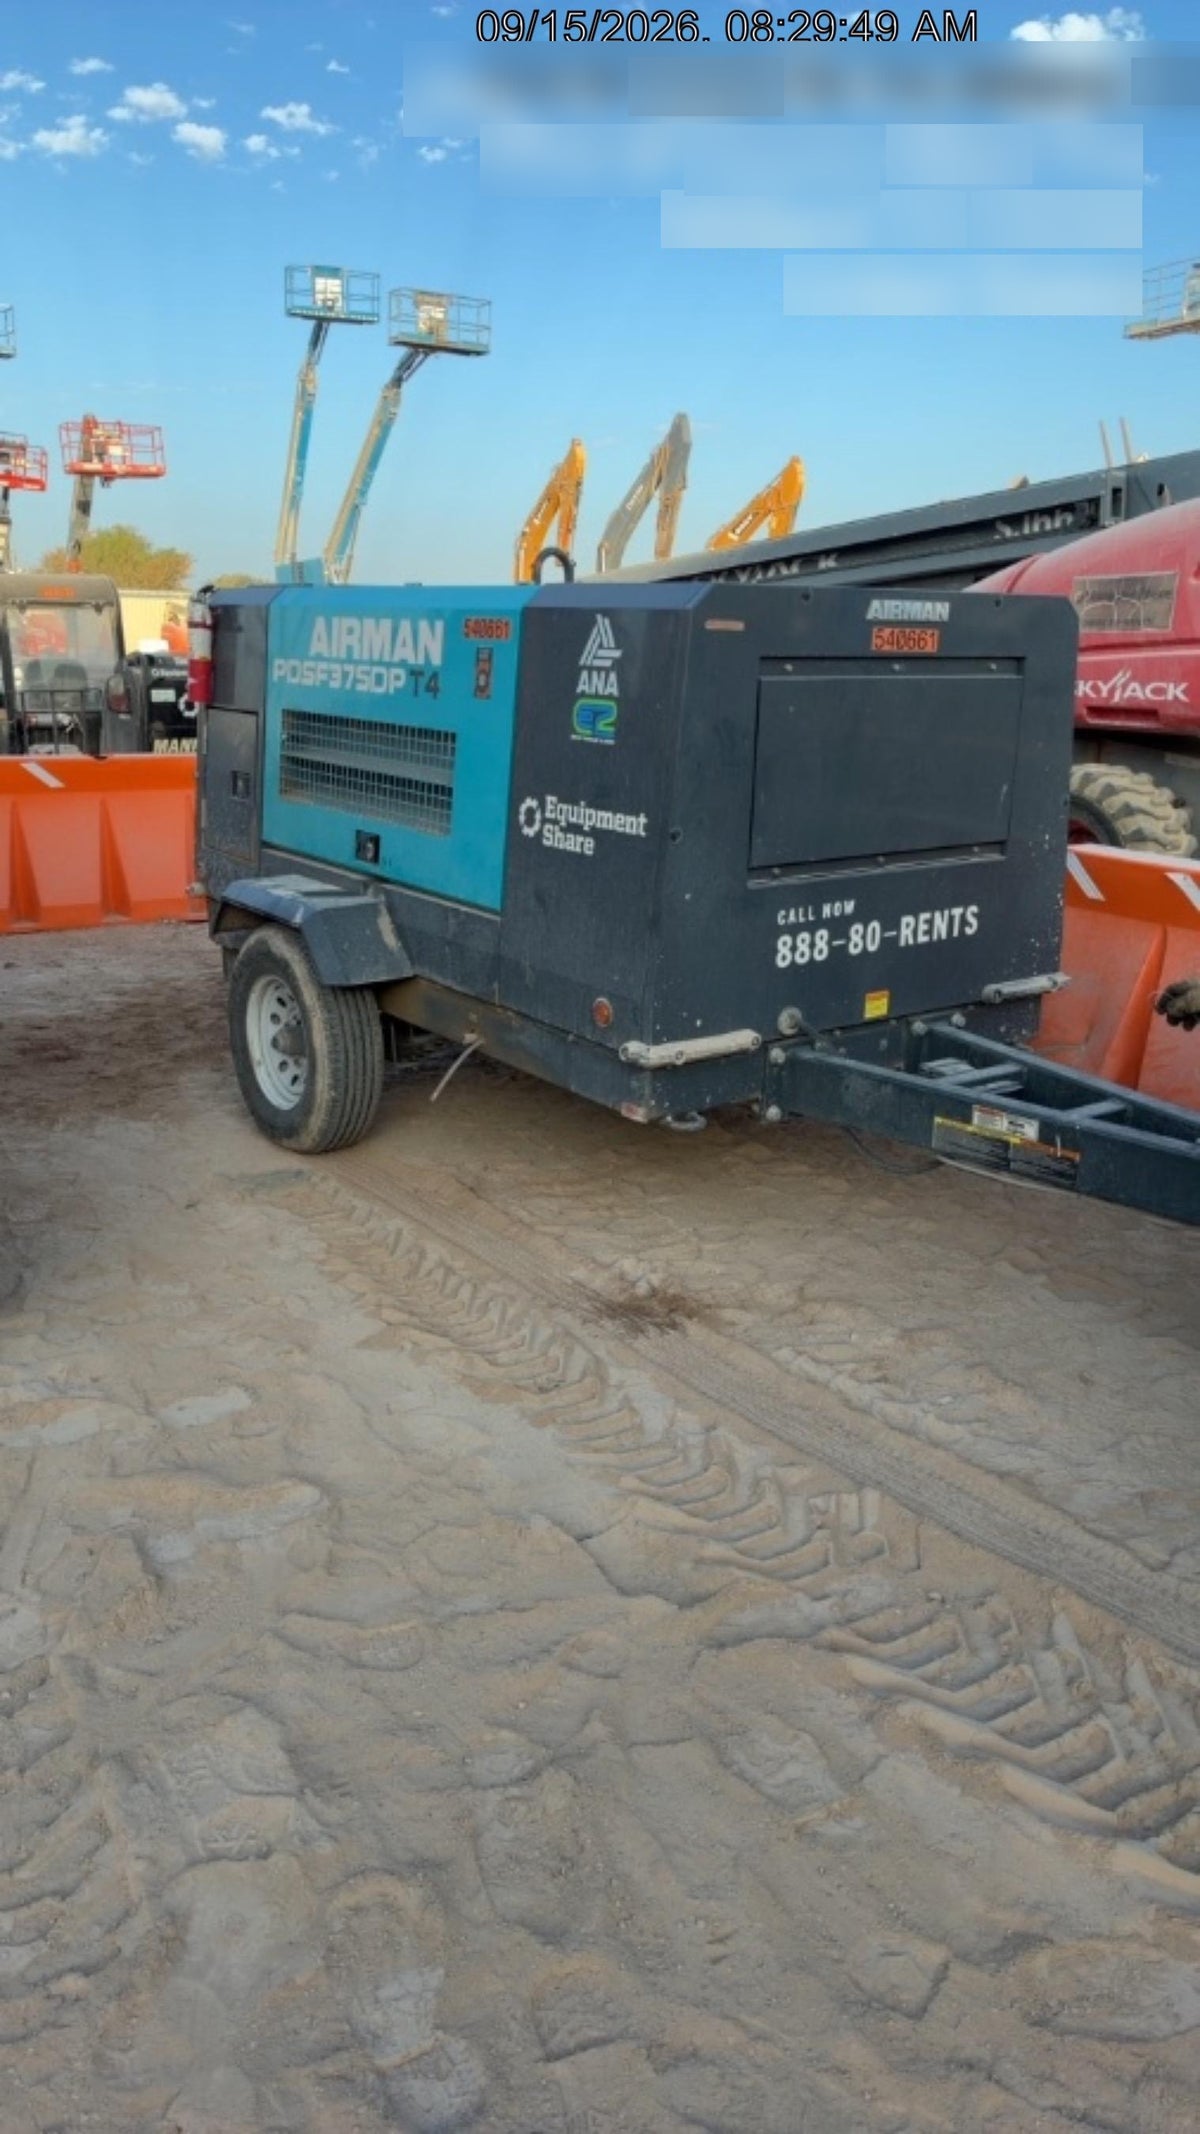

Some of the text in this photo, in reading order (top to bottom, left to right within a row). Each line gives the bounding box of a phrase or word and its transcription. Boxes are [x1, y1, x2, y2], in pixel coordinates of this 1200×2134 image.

[865, 599, 950, 622] AIRMAN
[307, 615, 445, 667] AIRMAN
[872, 628, 939, 652] 540661
[409, 670, 441, 700] T4
[576, 669, 619, 698] ANA
[1074, 667, 1190, 704] KYJACK
[544, 795, 648, 838] Equipment
[542, 822, 595, 856] Share
[777, 899, 856, 926] CALL NOW
[775, 904, 980, 969] 888-80-RENTS
